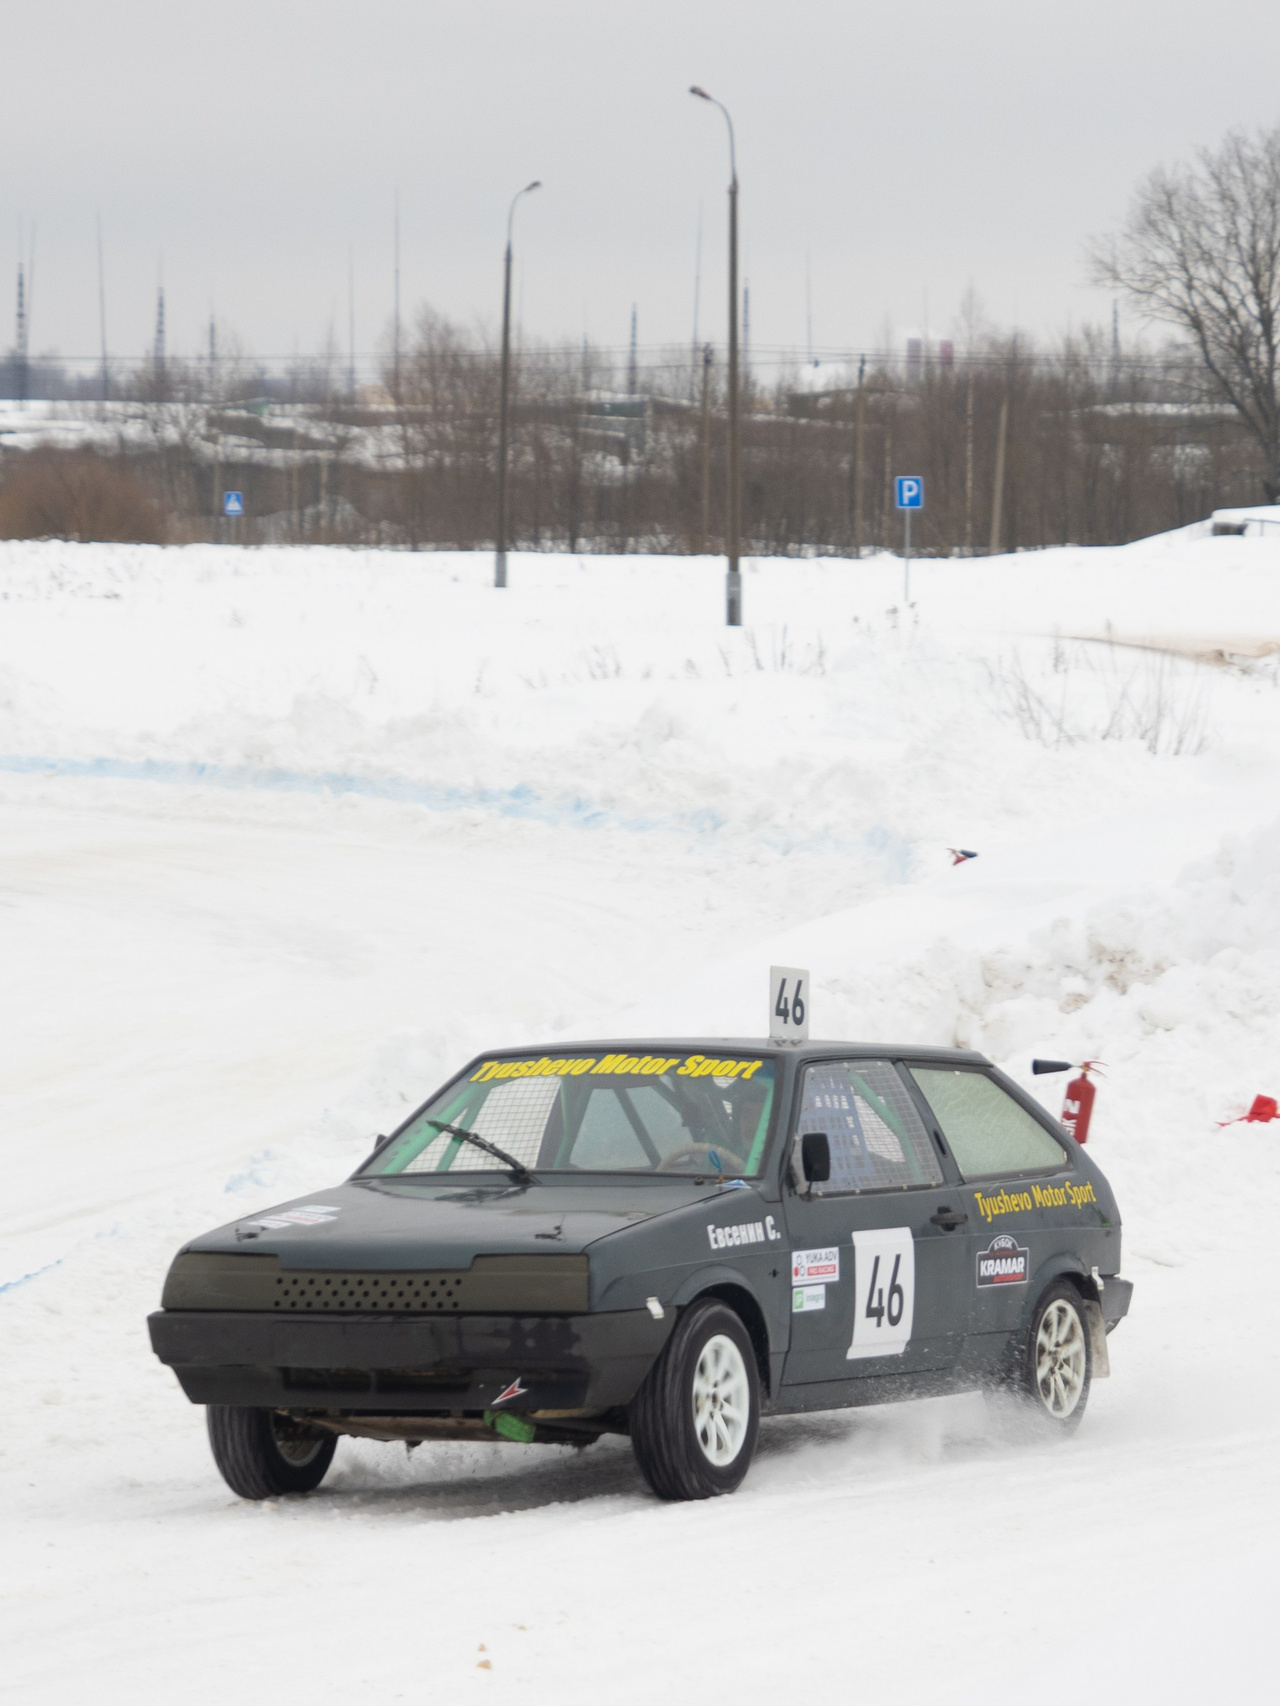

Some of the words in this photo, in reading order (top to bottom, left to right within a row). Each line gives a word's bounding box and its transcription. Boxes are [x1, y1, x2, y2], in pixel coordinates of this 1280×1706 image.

[902, 480, 918, 504] P
[775, 977, 805, 1026] 46
[469, 1057, 597, 1082] Tyushevo
[589, 1054, 681, 1075] Motor
[676, 1055, 763, 1079] Sport
[974, 1188, 1032, 1222] Tyushevo
[1031, 1184, 1068, 1209] Motor
[1065, 1181, 1097, 1210] Sport
[706, 1221, 765, 1250] Евсенин
[765, 1215, 781, 1240] С.
[980, 1256, 1025, 1277] KRAMAR
[865, 1253, 904, 1327] 46
